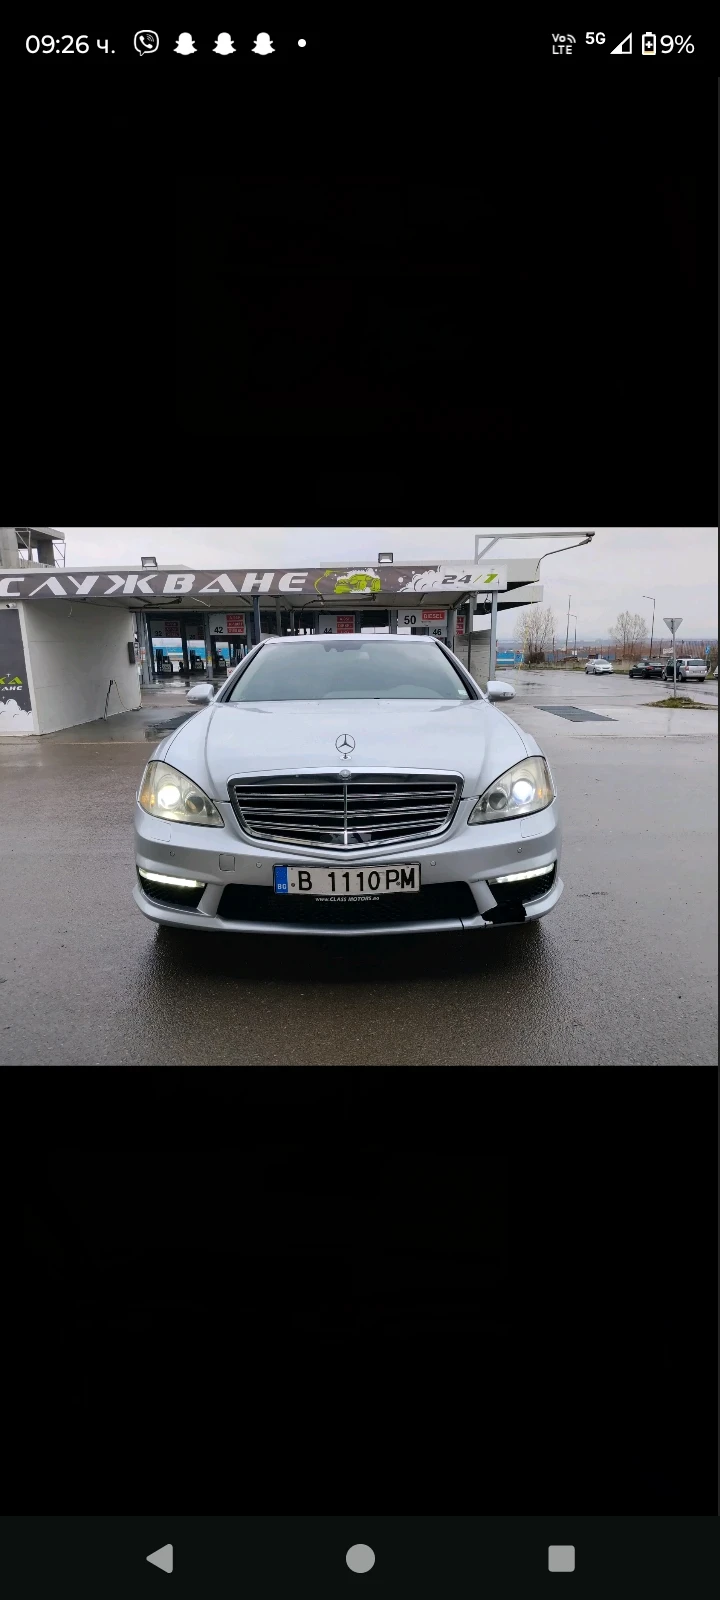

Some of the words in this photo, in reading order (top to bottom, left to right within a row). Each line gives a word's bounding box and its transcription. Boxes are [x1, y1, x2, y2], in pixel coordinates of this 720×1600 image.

[441, 573, 498, 584] 24/7
[404, 615, 416, 625] 50
[214, 626, 223, 634] 42
[298, 870, 313, 891] B
